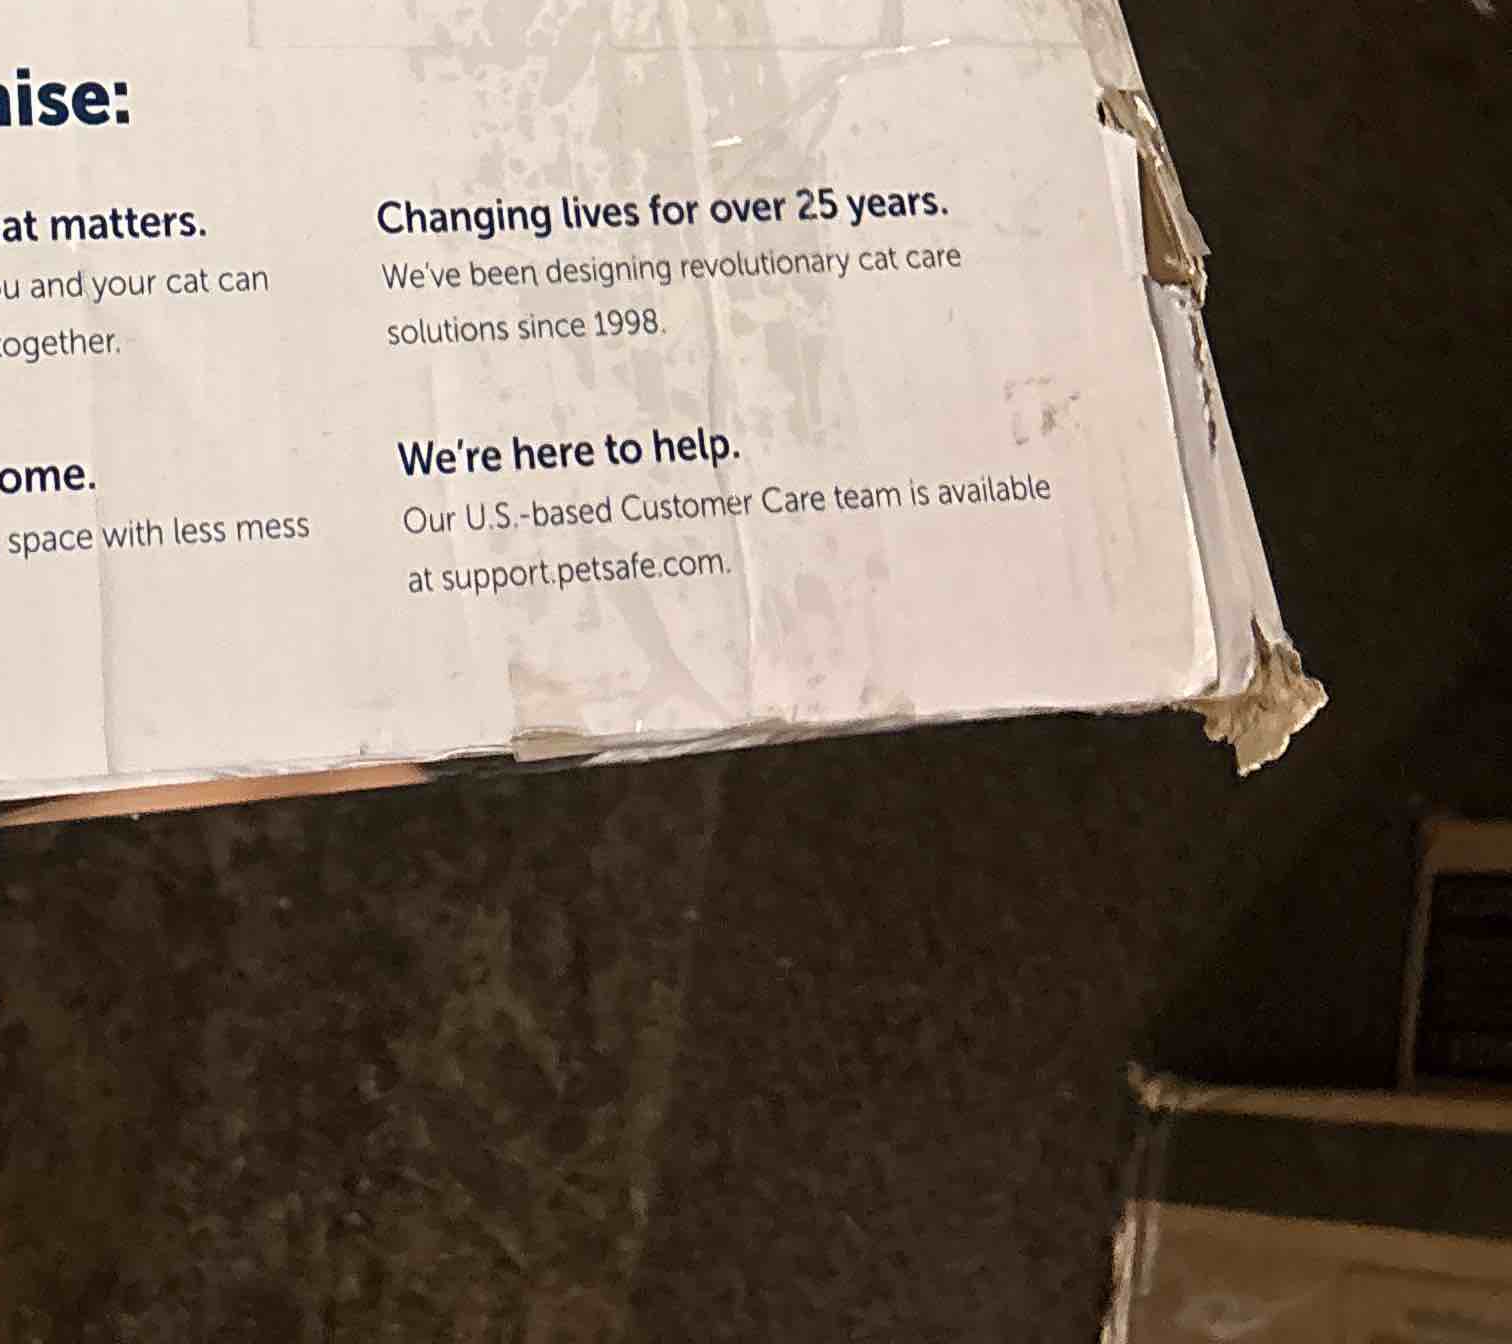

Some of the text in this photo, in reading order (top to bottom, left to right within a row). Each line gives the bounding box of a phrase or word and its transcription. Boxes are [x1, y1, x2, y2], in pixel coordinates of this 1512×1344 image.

[50, 205, 207, 242] matters.
[377, 189, 949, 238] Changing lives for over 25 years.
[29, 271, 85, 300] and
[92, 276, 156, 303] your
[165, 268, 210, 294] cat
[218, 269, 270, 292] can
[382, 243, 962, 290] We've been designing revolutionary cat care
[387, 308, 667, 346] solutions since 1998.
[397, 427, 741, 475] We're here to help.
[403, 473, 1052, 534] Our U.S.-based Customer Care team is available
[8, 528, 94, 560] space
[101, 521, 165, 548] with
[174, 518, 227, 544] less
[236, 518, 310, 542] mess
[407, 552, 732, 595] at support.petsafe.com.
